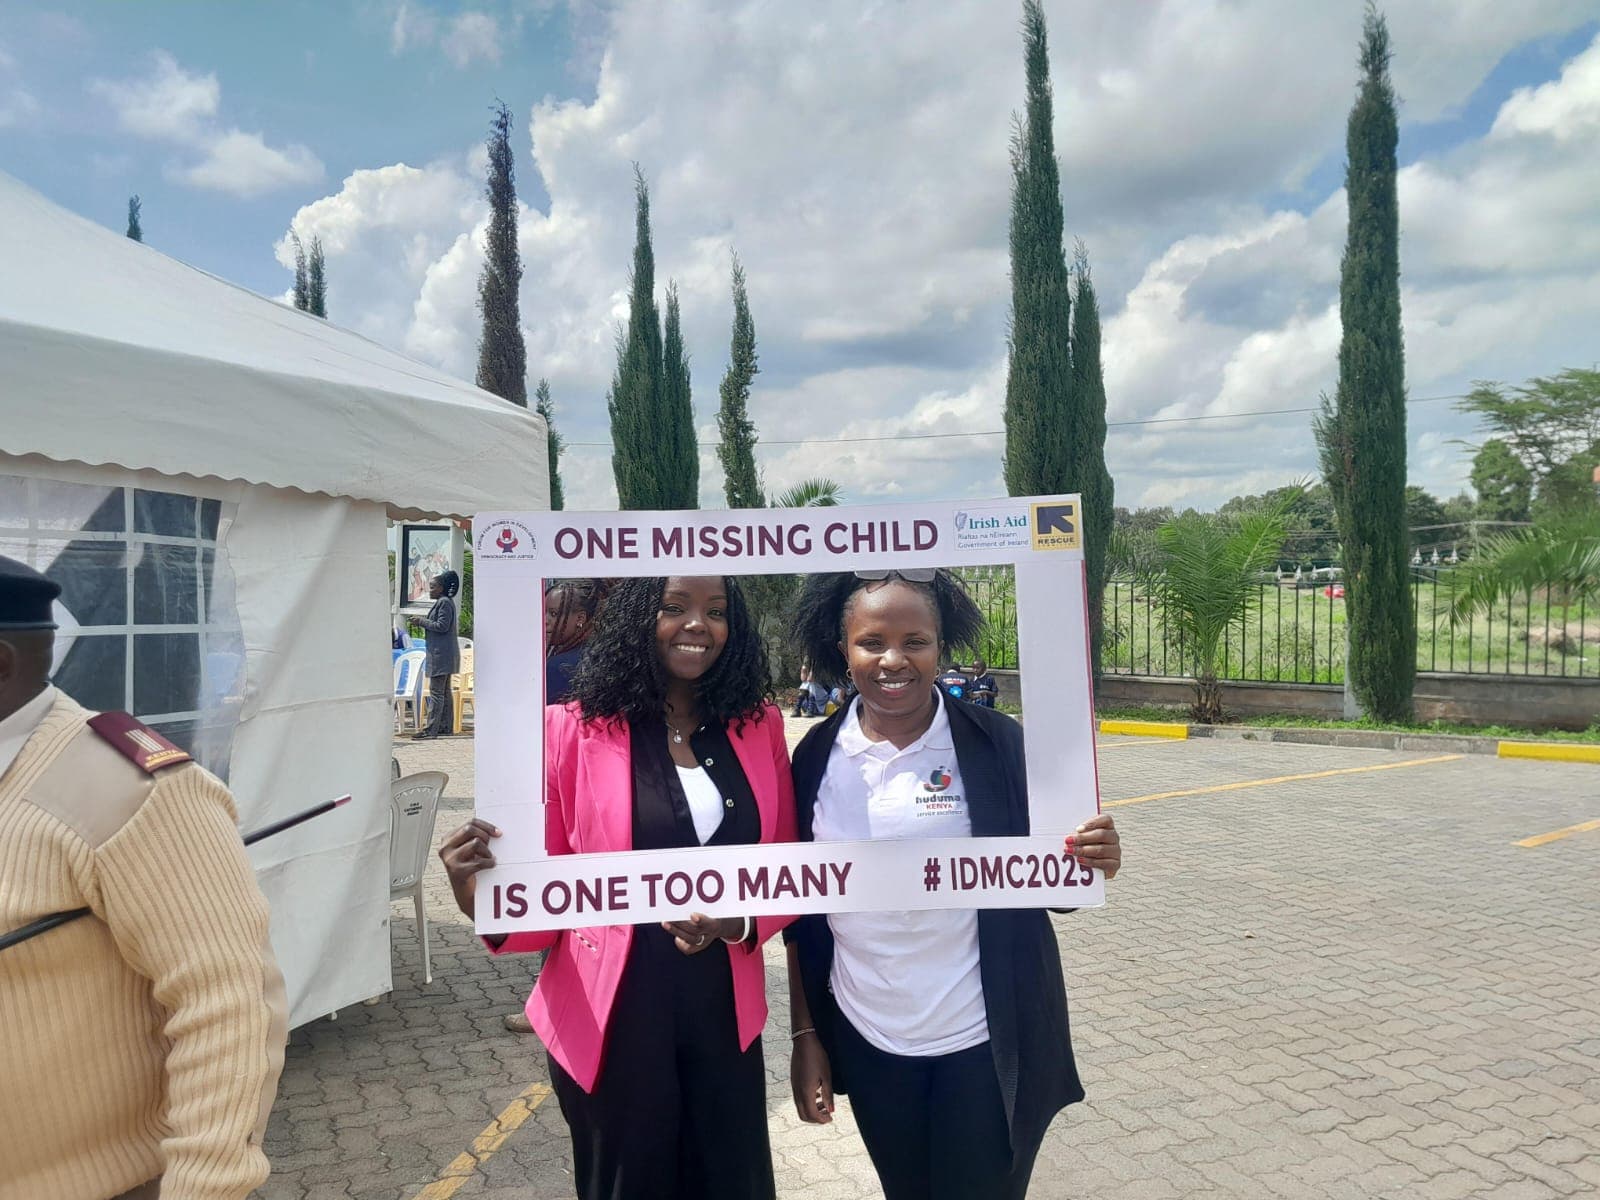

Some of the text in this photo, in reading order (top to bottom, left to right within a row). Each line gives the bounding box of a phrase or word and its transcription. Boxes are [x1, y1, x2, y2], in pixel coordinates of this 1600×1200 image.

[969, 515, 1027, 530] Irish Aid
[554, 519, 938, 560] ONE MISSING CHILD
[958, 541, 997, 549] Government
[1037, 537, 1075, 545] RESCUE
[915, 794, 961, 804] huduma
[493, 862, 853, 919] IS ONE TOO MANY
